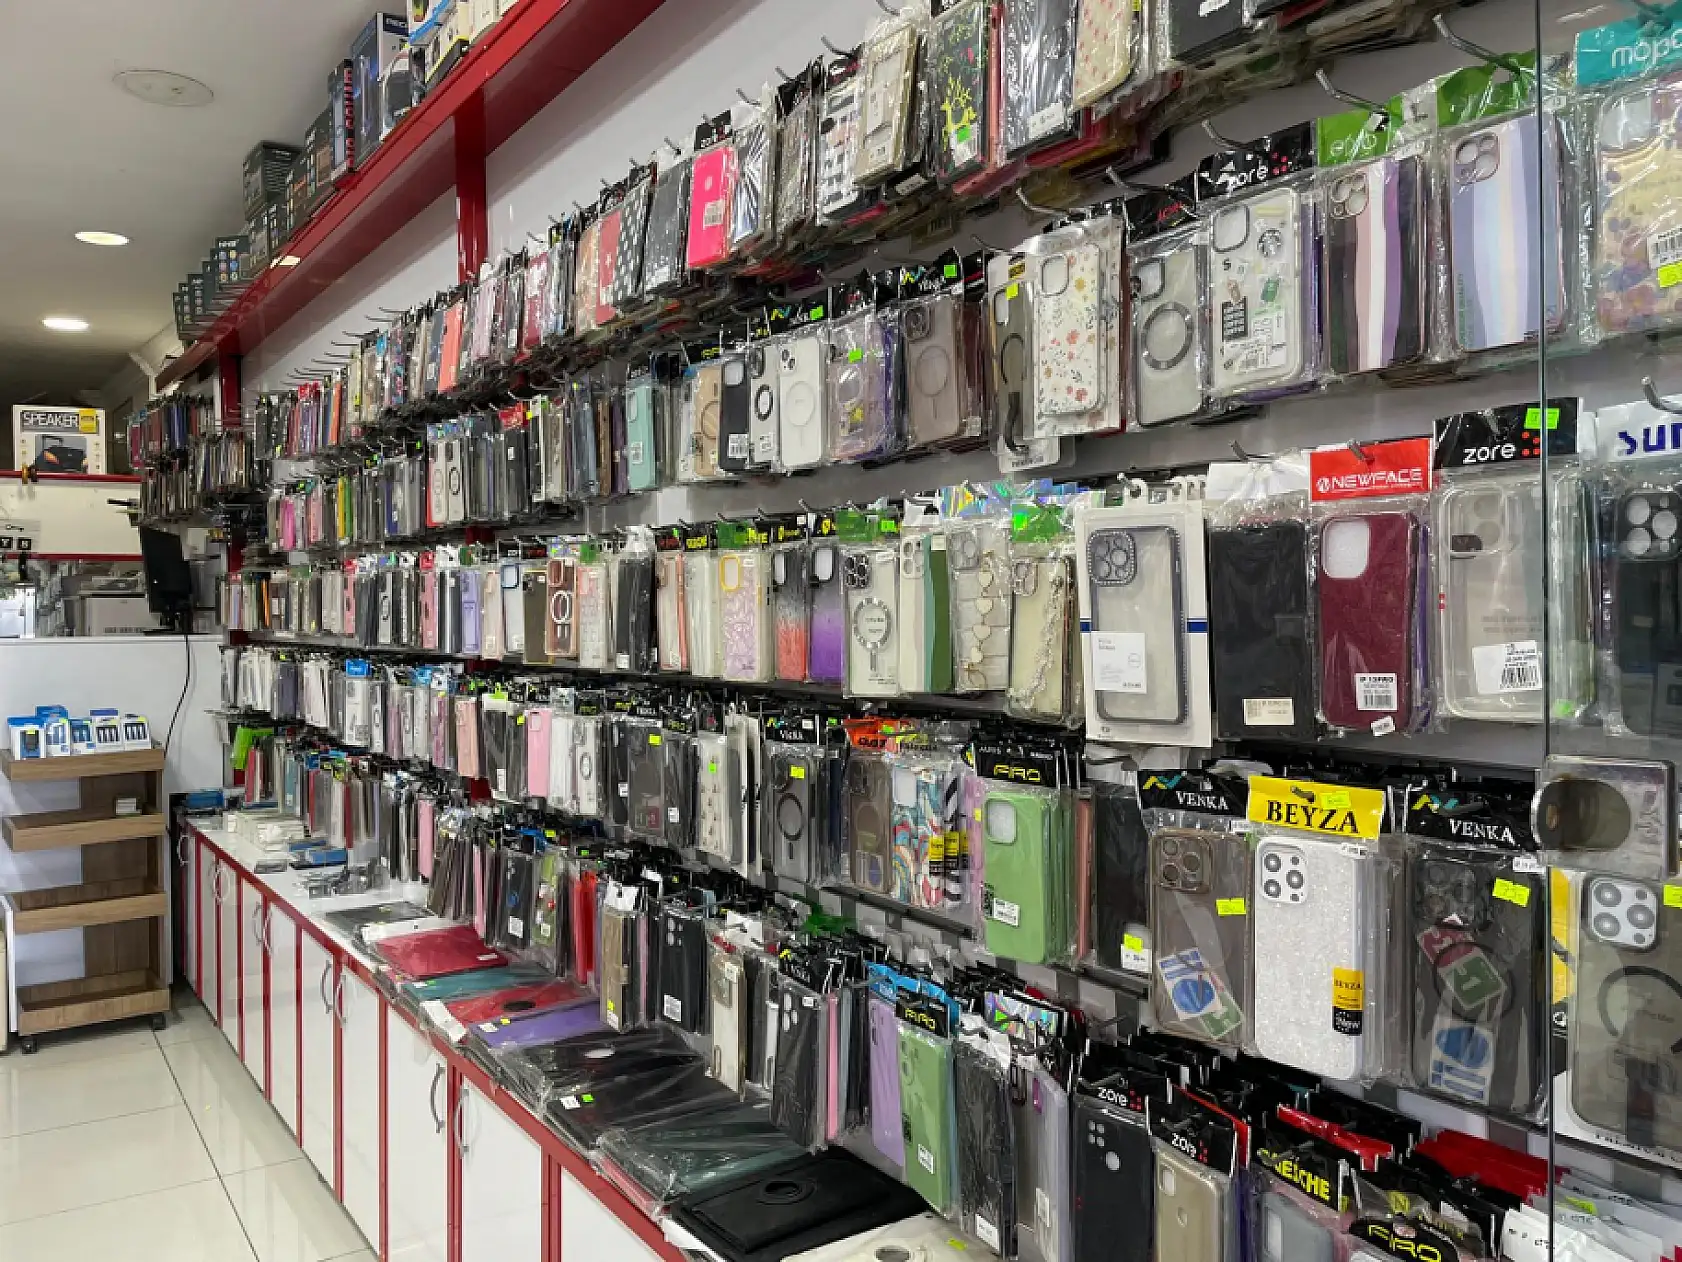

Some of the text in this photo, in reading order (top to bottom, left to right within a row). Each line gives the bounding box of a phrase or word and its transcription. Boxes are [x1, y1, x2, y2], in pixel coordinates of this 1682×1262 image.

[23, 411, 79, 428] SPEAKER
[1462, 442, 1516, 465] zore
[1331, 468, 1423, 489] NEWFACE
[1175, 790, 1229, 810] VENKA
[1266, 799, 1359, 834] BEYZA
[1449, 818, 1516, 846] VENKA
[1098, 1086, 1129, 1107] zore
